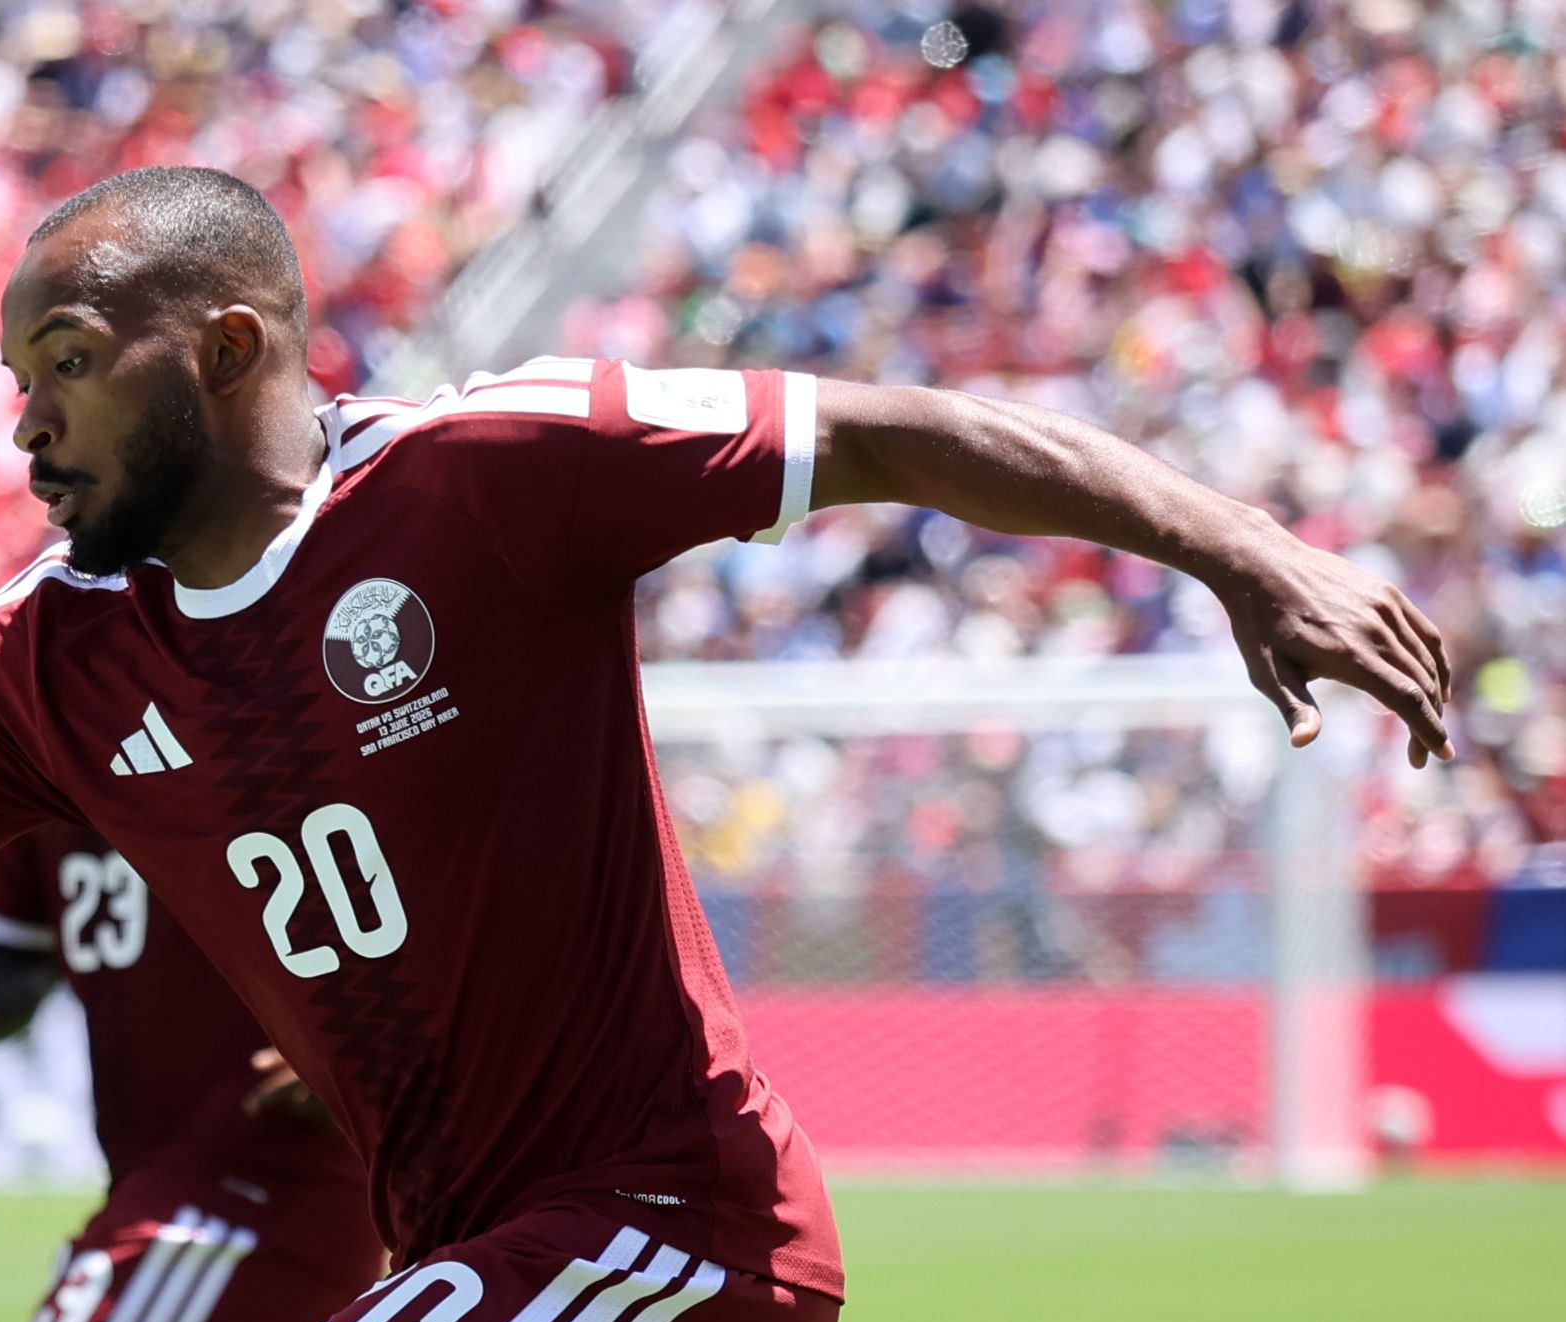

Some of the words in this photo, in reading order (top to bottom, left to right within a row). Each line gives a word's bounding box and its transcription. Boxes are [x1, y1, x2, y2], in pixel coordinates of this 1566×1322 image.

[363, 659, 418, 697] QFA
[355, 717, 381, 734] QATAR
[381, 711, 393, 724] VS
[392, 687, 449, 719] SWITZERLAND
[360, 743, 378, 757] SAN
[376, 725, 420, 750] FRANCISCO
[420, 718, 437, 732] BAY
[437, 707, 460, 725] AREA
[378, 726, 389, 737] 13
[389, 717, 410, 733] JUNE
[410, 707, 433, 724] 2026
[60, 851, 148, 973] 23
[226, 803, 408, 978] 20
